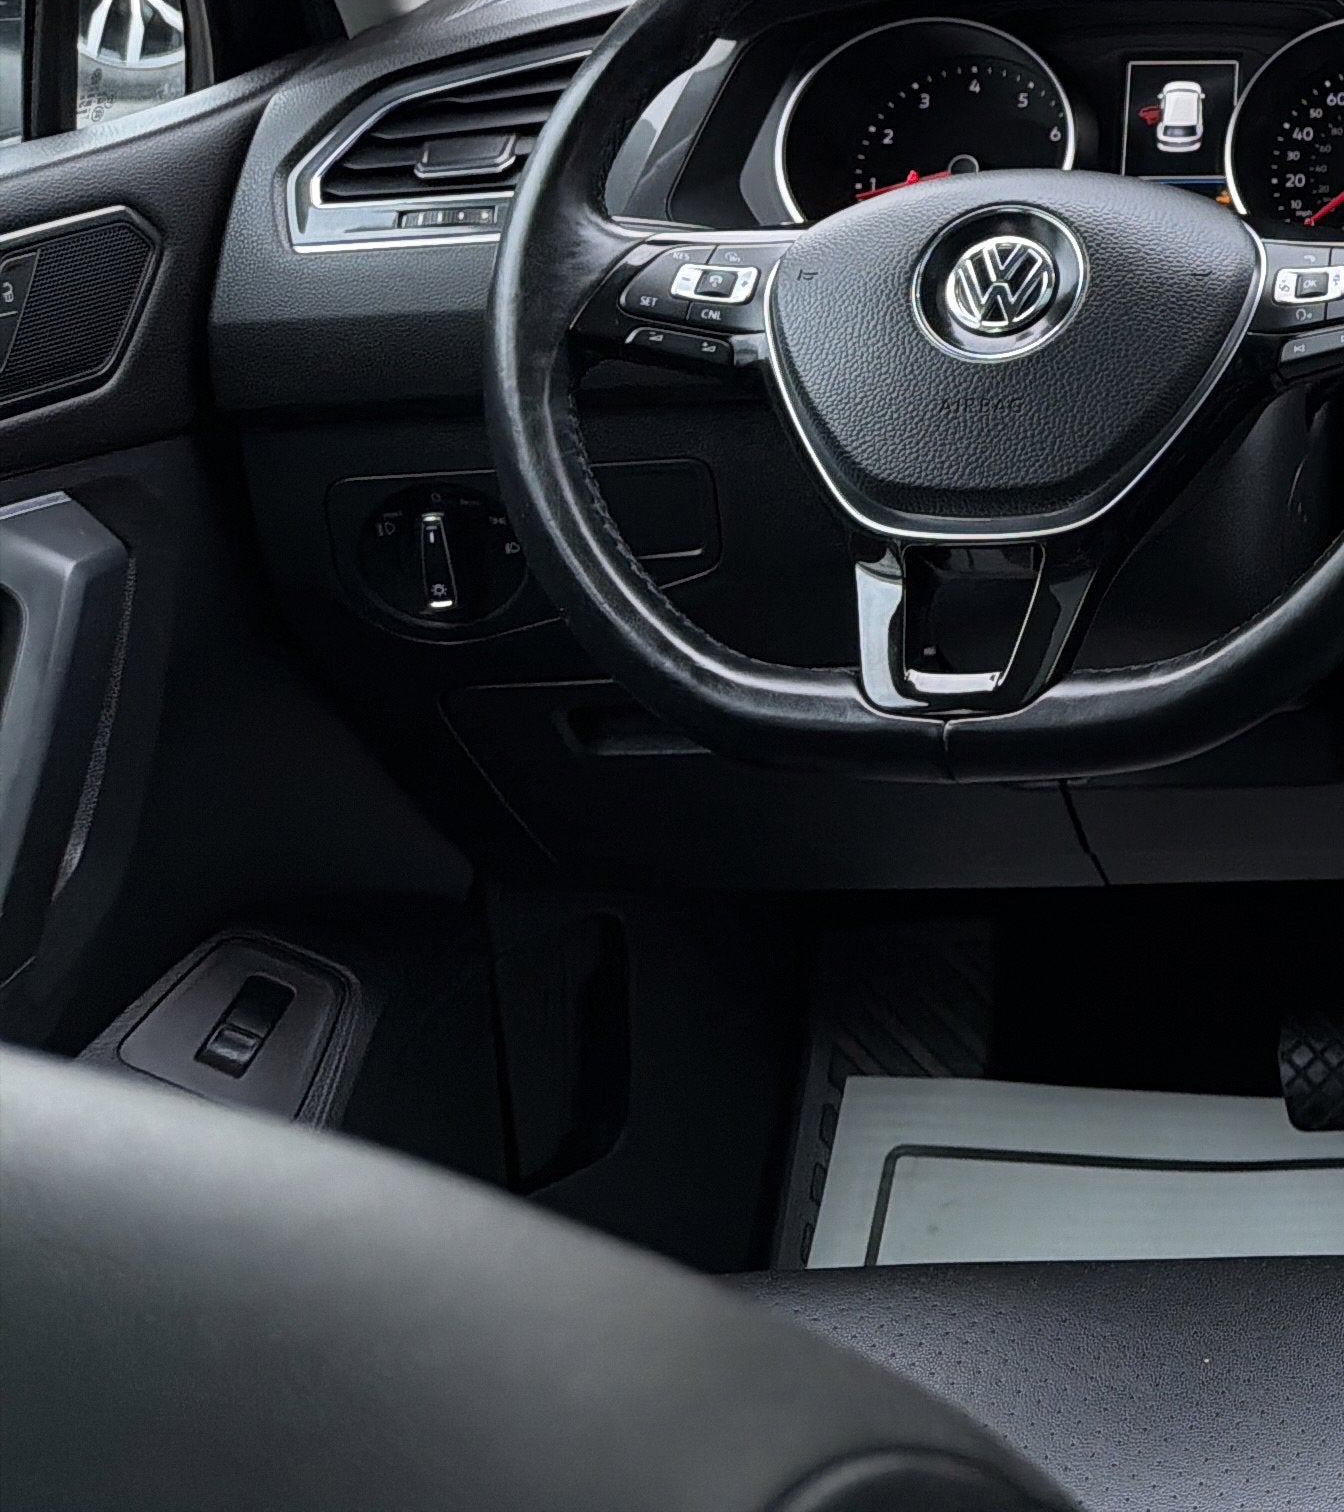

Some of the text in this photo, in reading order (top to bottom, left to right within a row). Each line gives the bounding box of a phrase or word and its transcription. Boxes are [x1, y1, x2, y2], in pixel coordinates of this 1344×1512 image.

[969, 79, 981, 94] 4
[919, 93, 930, 109] 3
[1017, 93, 1028, 108] 5
[1309, 108, 1323, 118] 50
[882, 129, 894, 144] 2
[1050, 126, 1062, 142] 6
[1292, 127, 1314, 141] 40
[1286, 150, 1300, 161] 30
[1285, 174, 1306, 188] 20
[1290, 200, 1302, 210] 10
[1302, 279, 1318, 289] OK
[640, 296, 659, 307] SET
[701, 309, 722, 321] CNL
